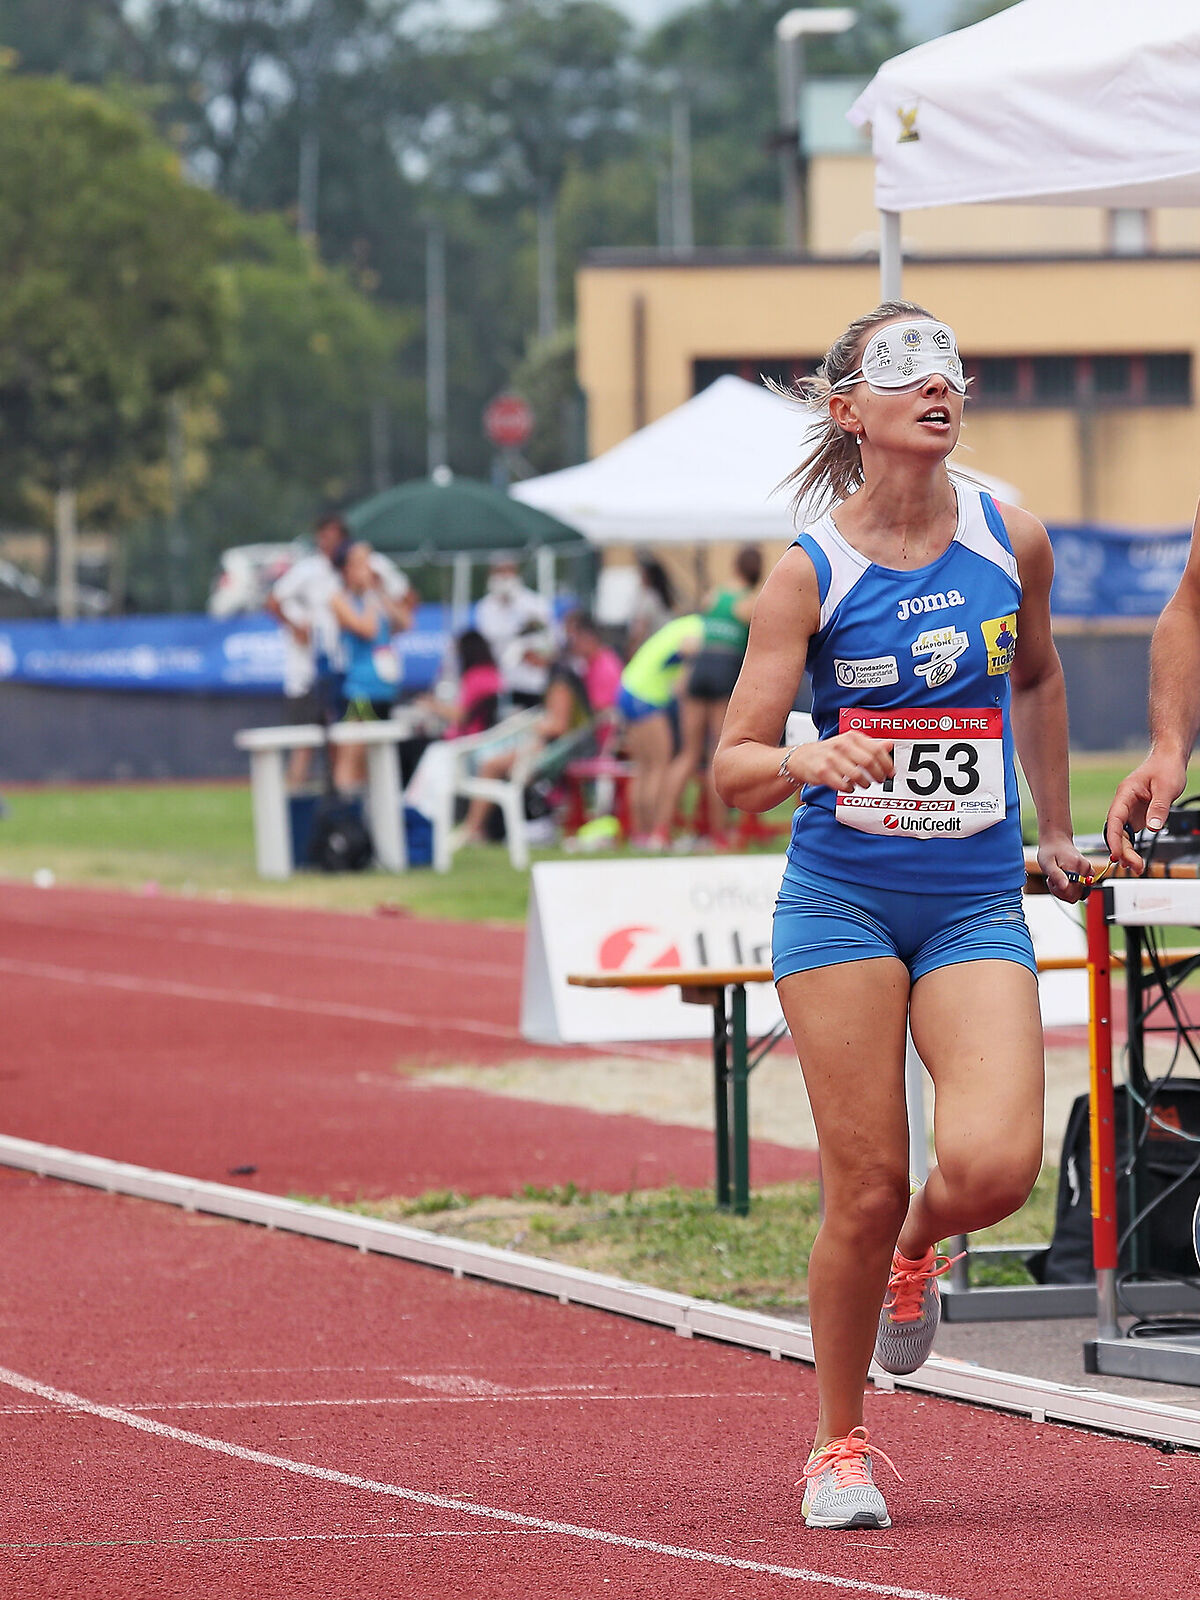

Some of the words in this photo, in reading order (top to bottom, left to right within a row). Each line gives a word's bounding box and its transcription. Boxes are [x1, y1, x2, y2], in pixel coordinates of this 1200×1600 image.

[897, 589, 966, 621] Joma
[915, 639, 951, 651] SEMPIONE
[991, 651, 1015, 667] TIGR
[856, 663, 894, 672] Fondazione
[842, 797, 918, 810] CONCESIO
[918, 800, 953, 811] 2021
[960, 801, 992, 809] FISPES
[900, 816, 962, 832] UniCredit
